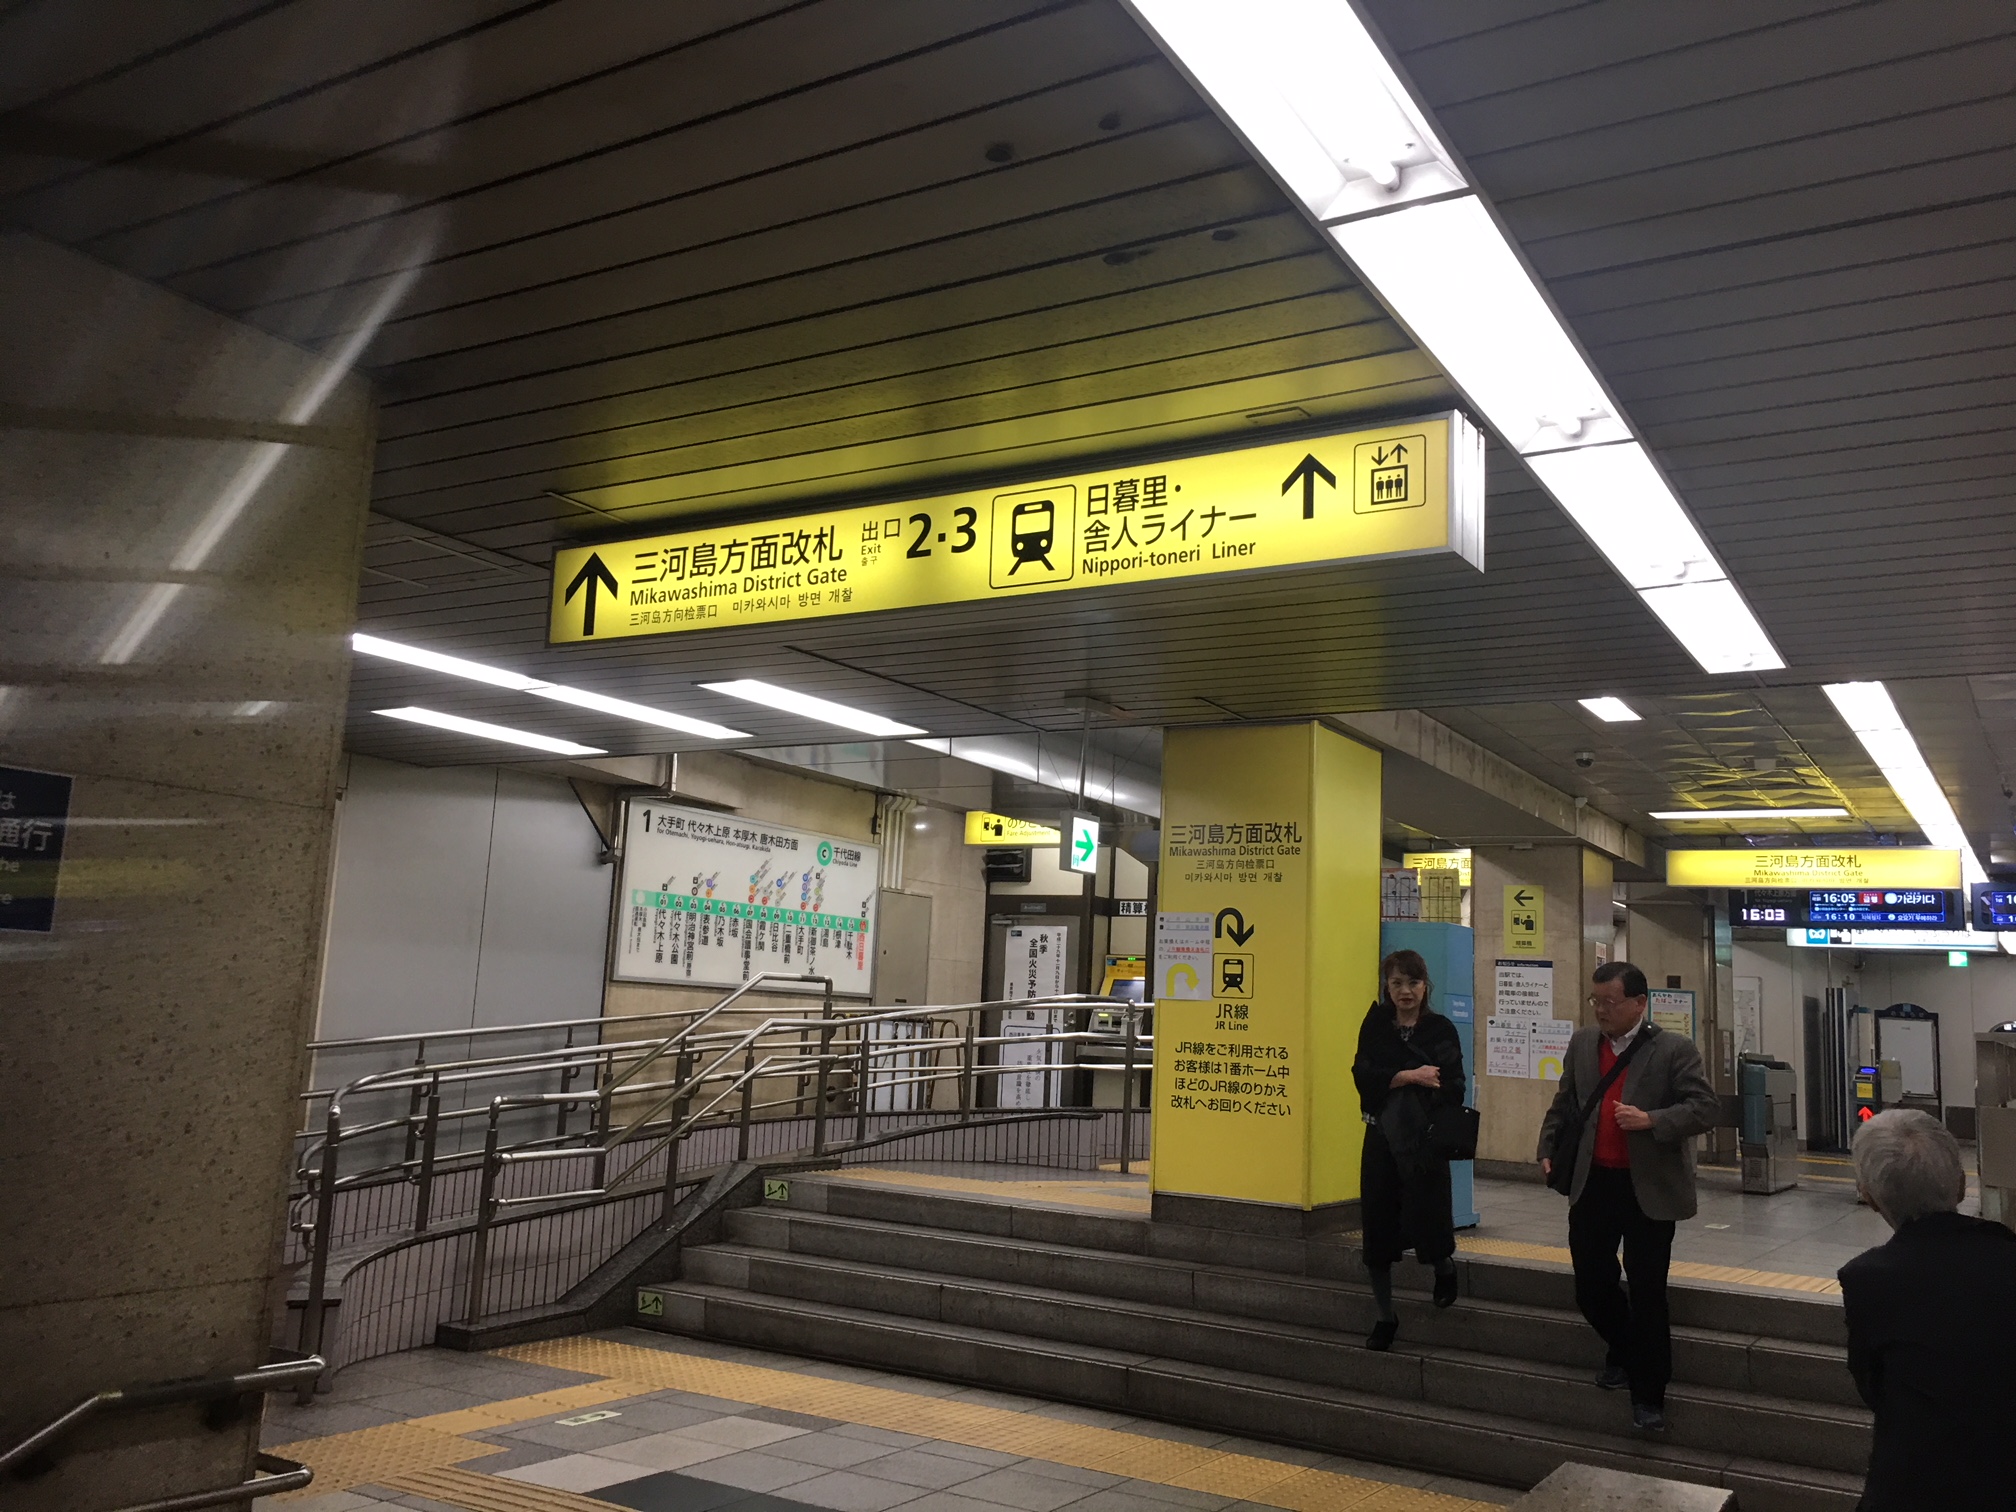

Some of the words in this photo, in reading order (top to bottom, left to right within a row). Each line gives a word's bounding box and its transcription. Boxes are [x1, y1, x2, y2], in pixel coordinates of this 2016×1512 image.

[1087, 475, 1182, 519] 日暮里・
[861, 517, 901, 542] 出口
[1083, 507, 1258, 556] 舎人ライナー
[631, 523, 843, 586] 三河島方面改札
[860, 542, 882, 556] Exit
[1082, 545, 1201, 578] Nippori-toneri
[1211, 539, 1257, 561] Liner
[860, 554, 879, 567] 출구
[630, 579, 738, 607] Mikawashima
[743, 570, 802, 595] District
[806, 567, 848, 587] Gate
[731, 593, 791, 615] 미카와시마
[797, 590, 822, 608] 방면
[828, 586, 854, 604] 개찰
[628, 603, 719, 627] 三河岛方向检票口
[642, 808, 652, 833] 1
[656, 827, 664, 835] for
[657, 814, 686, 831] 大手町
[687, 819, 731, 839] 代々木上原
[733, 828, 758, 843] 本厚木
[760, 833, 799, 852] 唐木田方面
[1169, 821, 1303, 845] 三河島方面改札
[821, 848, 828, 859] C
[833, 846, 862, 863] 千代田線
[1168, 845, 1237, 857] Mikawashima
[1238, 844, 1275, 856] District
[1276, 844, 1302, 856] Gate
[1195, 858, 1276, 871] 三河岛方向检票口
[1755, 854, 1862, 869] 三河島方面改札
[1184, 872, 1233, 884] 미카와시마
[1238, 872, 1258, 883] 방면
[1262, 871, 1283, 883] 개찰
[1753, 869, 1810, 877] Mikawashima
[1823, 893, 1856, 904] 16:05
[1897, 894, 1936, 905] 가라키다
[1741, 908, 1786, 922] 16:03
[1825, 913, 1856, 921] 16:10
[654, 908, 667, 964] 代々木上原
[670, 910, 682, 965] 代々木公園
[716, 915, 726, 948] 乃木坂
[771, 922, 779, 953] 日比谷
[796, 926, 805, 955] 大手町
[1039, 933, 1049, 955] 秋季
[1026, 938, 1038, 1021] 全国火災予防動
[1215, 1002, 1249, 1020] JR線
[1214, 1020, 1226, 1031] JR
[1228, 1020, 1249, 1032] Line
[1174, 1041, 1289, 1061] JR線をご利用される
[1173, 1059, 1290, 1079] お客様は1番ホーム中
[1174, 1077, 1289, 1098] ほどのJR線のりかえ
[1170, 1095, 1292, 1117] 改札へお回りください
